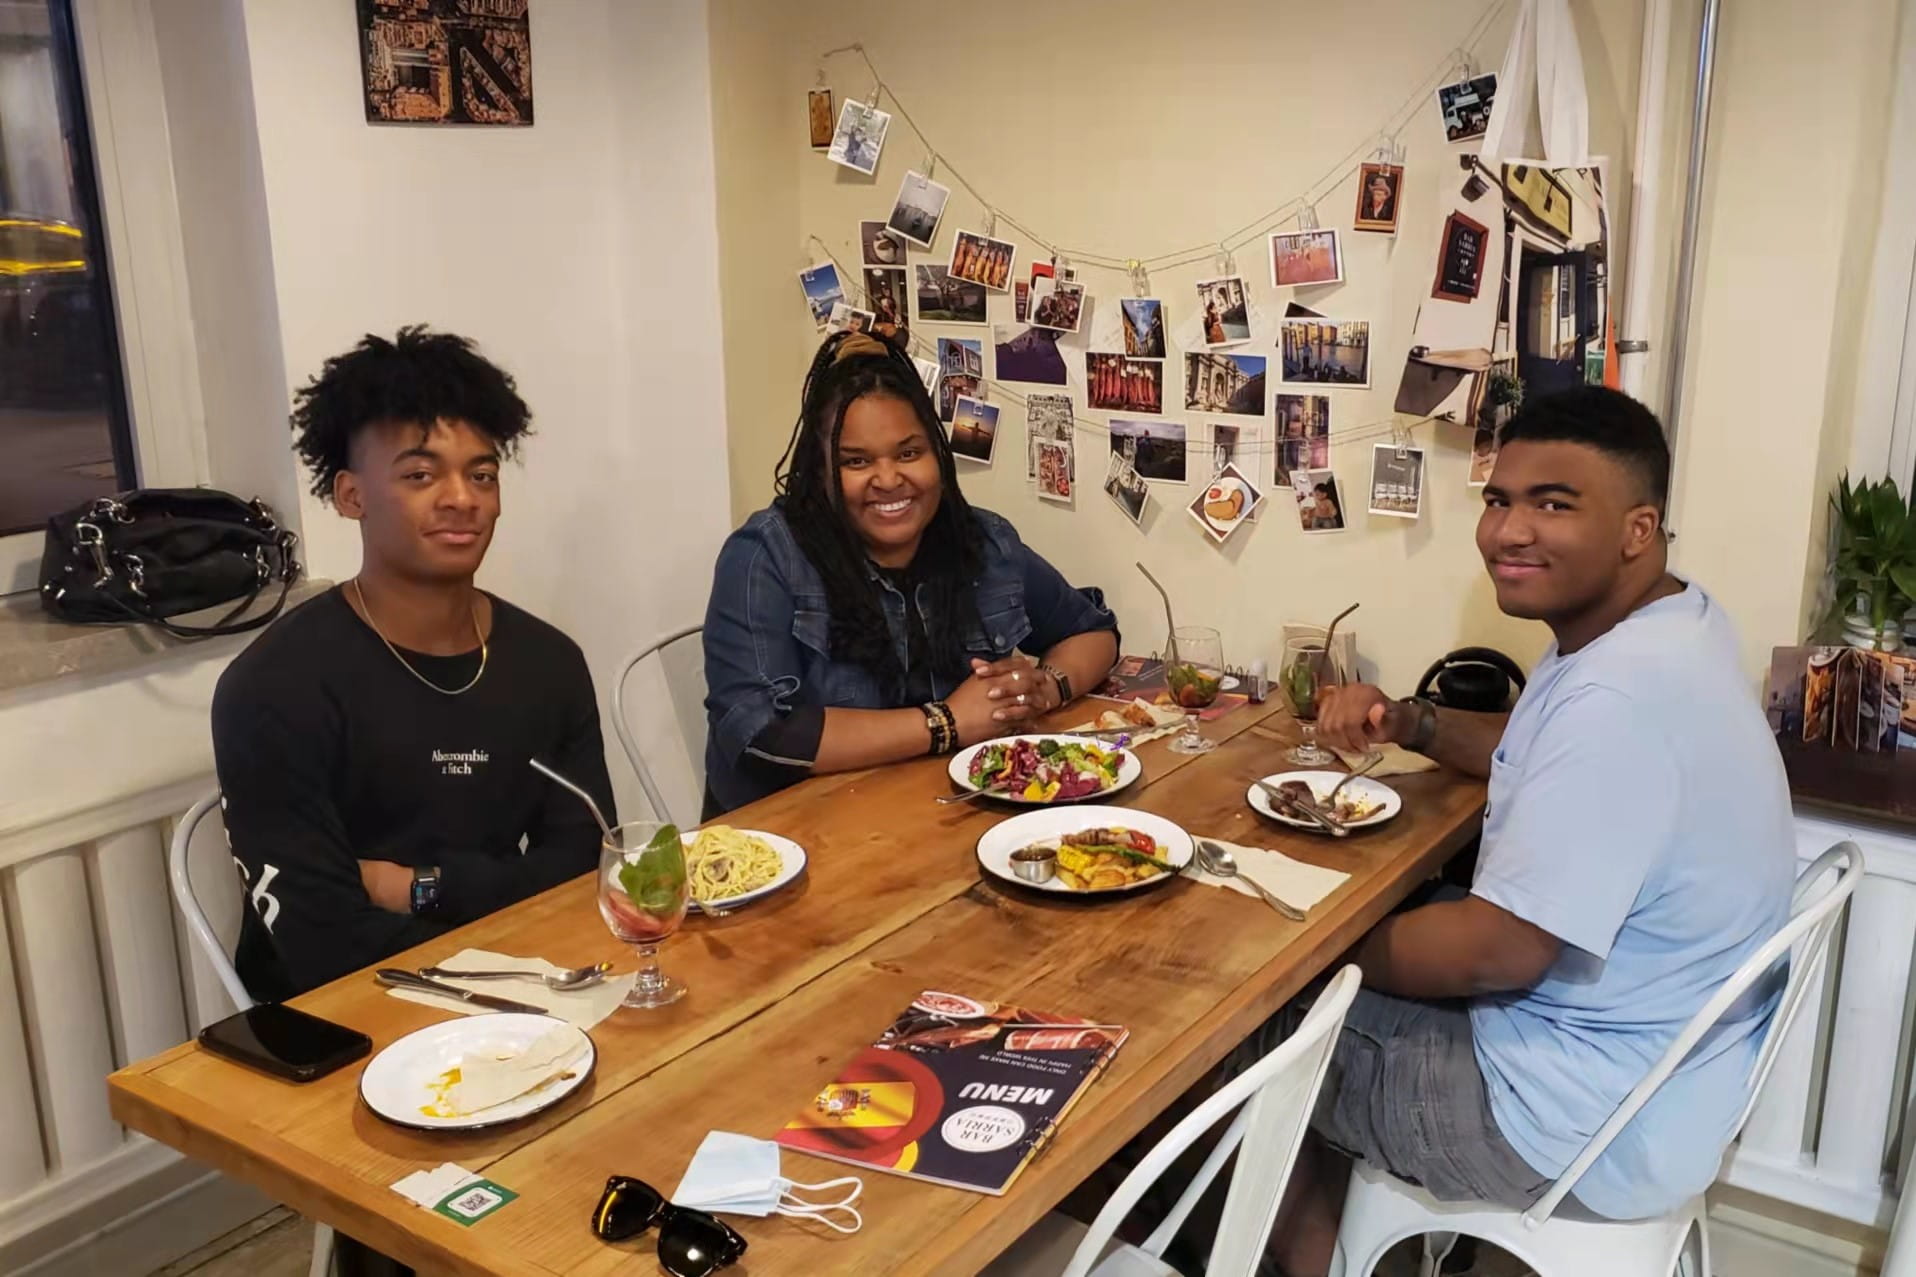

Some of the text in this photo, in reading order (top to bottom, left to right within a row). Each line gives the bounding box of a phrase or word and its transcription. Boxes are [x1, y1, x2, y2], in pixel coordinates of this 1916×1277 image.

[432, 749, 489, 762] Abercrombie
[448, 763, 472, 775] Fitch
[1026, 1063, 1047, 1071] FOOD
[1047, 1066, 1067, 1075] ONLY
[958, 1082, 1054, 1105] MENU
[957, 1117, 1013, 1136] SARRIA
[960, 1130, 993, 1143] BAR
